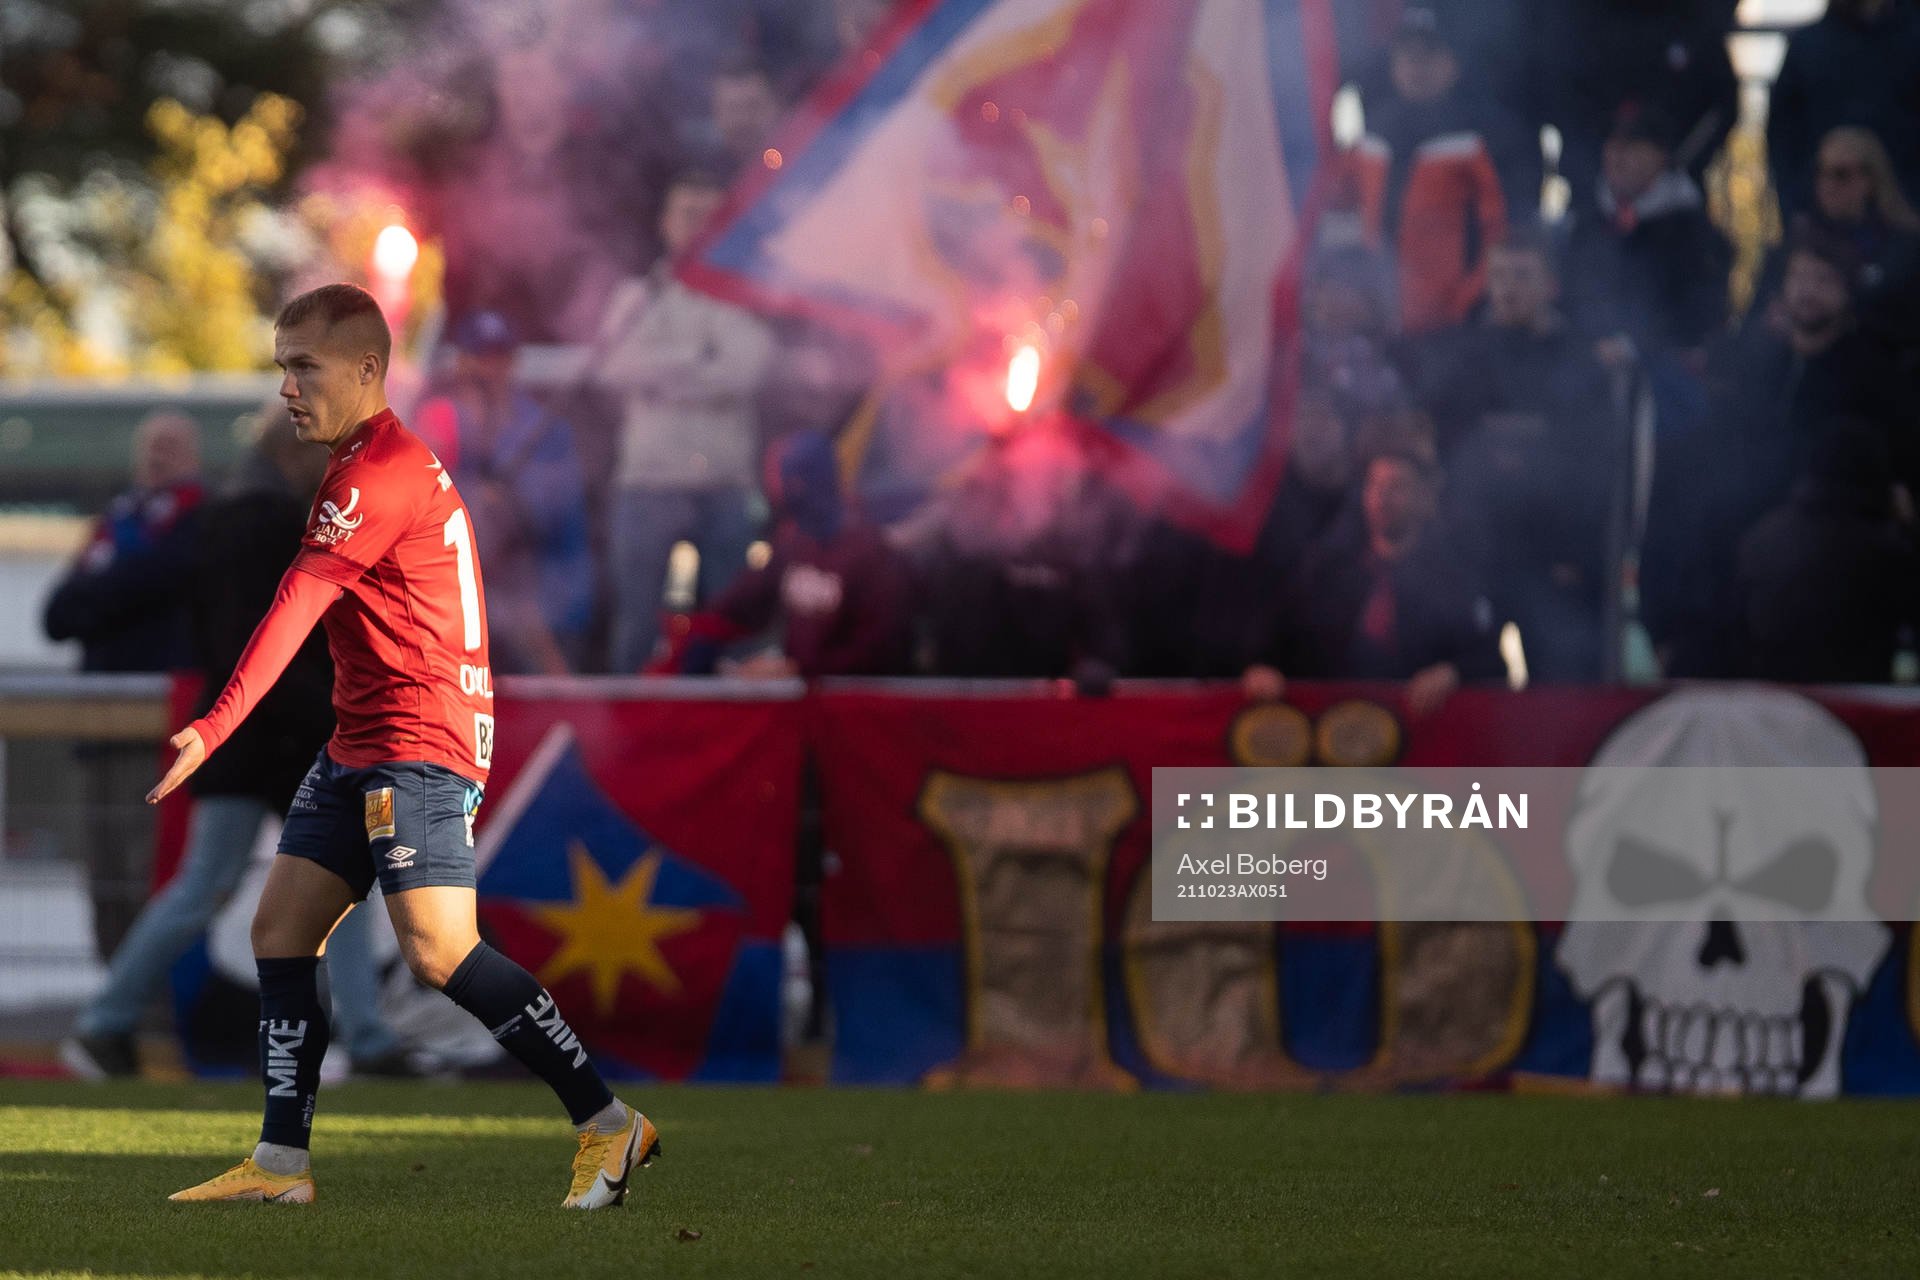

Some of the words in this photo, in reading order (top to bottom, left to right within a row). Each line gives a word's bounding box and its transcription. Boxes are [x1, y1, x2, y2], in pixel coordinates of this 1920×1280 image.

[311, 523, 355, 542] UALIY
[444, 508, 481, 651] 1
[388, 860, 414, 870] umbro
[525, 987, 588, 1069] MIKE
[267, 1019, 307, 1097] MIKE
[302, 1094, 315, 1128] umbro
